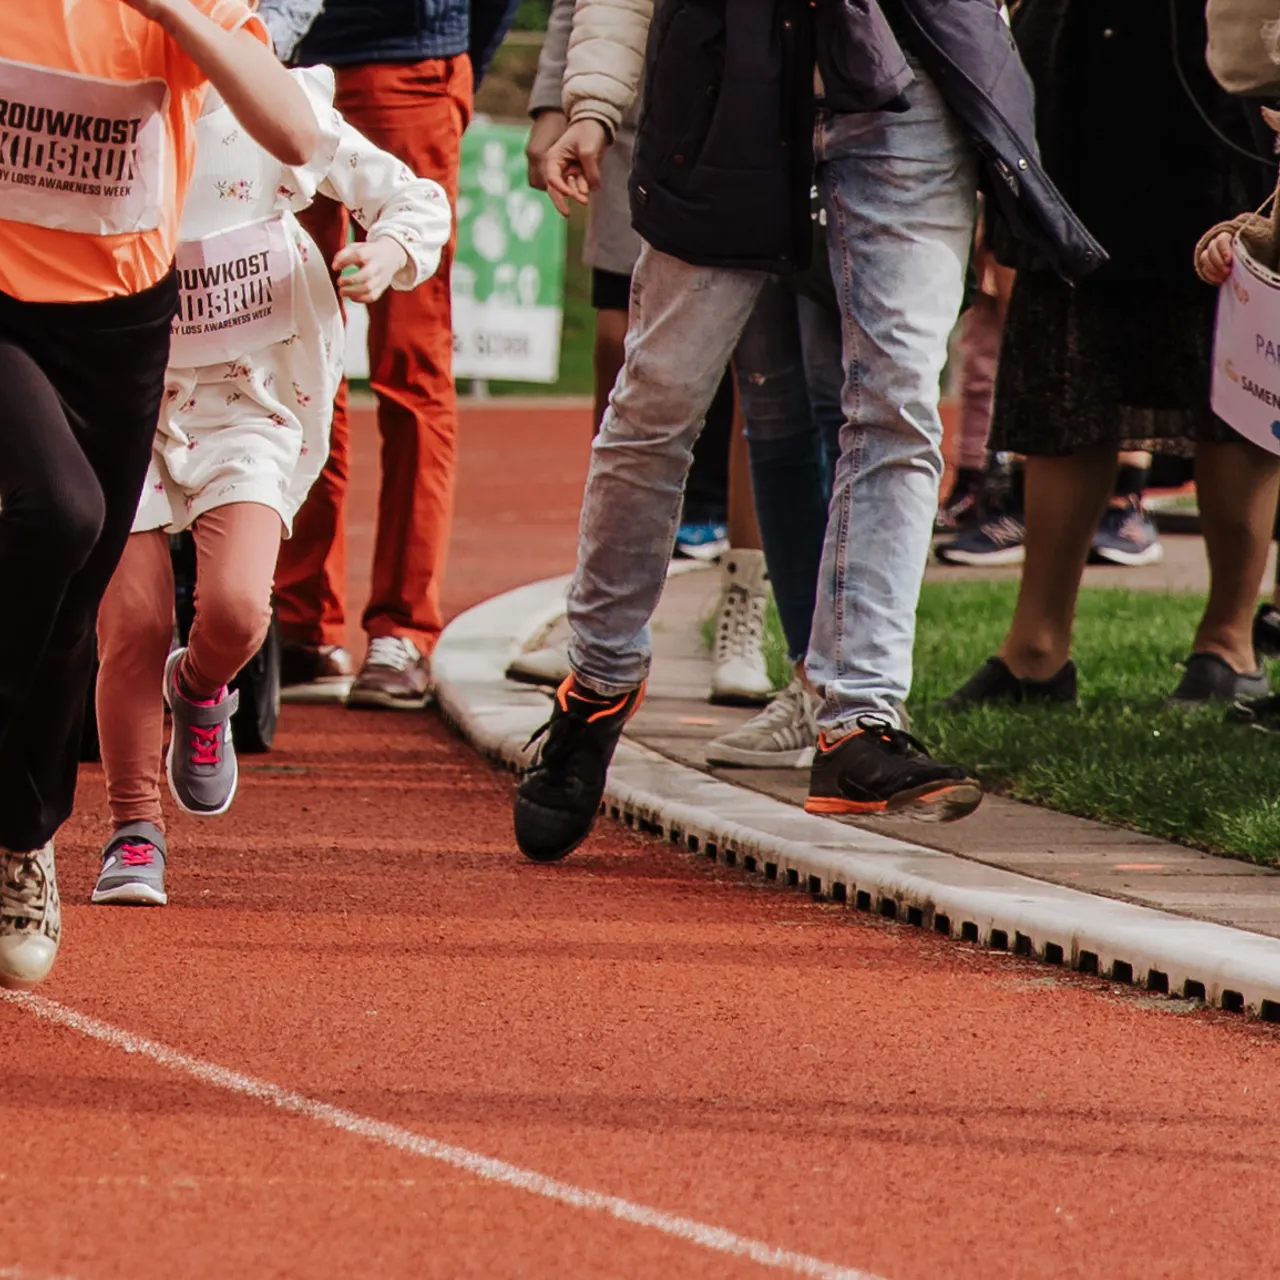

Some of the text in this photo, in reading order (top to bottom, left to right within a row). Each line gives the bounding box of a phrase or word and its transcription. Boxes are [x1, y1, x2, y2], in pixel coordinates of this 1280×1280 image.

[11, 172, 37, 187] LOSS
[37, 176, 101, 195] AWARENESS
[103, 184, 131, 197] WEEK
[181, 324, 202, 335] LOSS
[203, 313, 251, 333] AWARENESS
[252, 306, 272, 320] WEEK
[1256, 333, 1280, 365] PA
